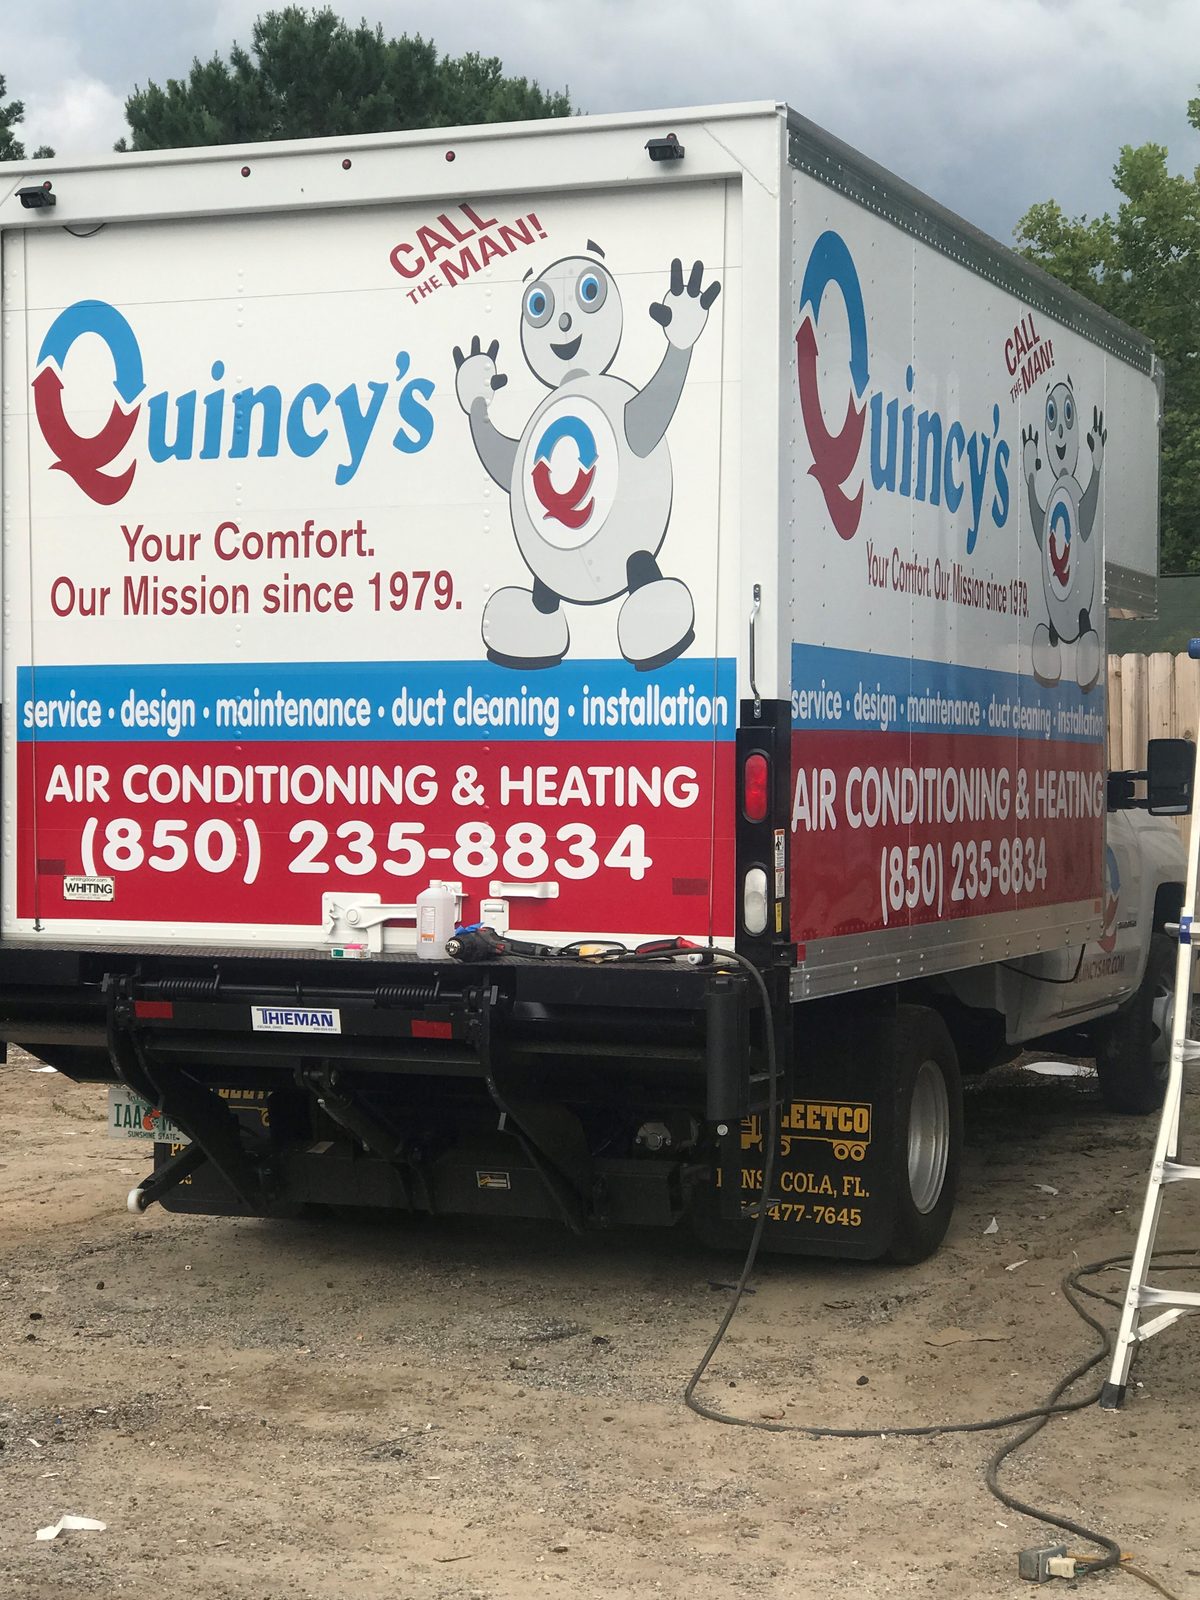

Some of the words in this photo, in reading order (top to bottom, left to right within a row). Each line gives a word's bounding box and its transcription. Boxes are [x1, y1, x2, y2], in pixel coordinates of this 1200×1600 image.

[389, 202, 498, 279] CALL
[406, 274, 443, 305] THE
[439, 212, 549, 288] MAN!
[1005, 312, 1040, 376] CALL
[1010, 378, 1023, 404] THE
[1021, 339, 1055, 394] MAN!
[31, 299, 436, 506] Quincy's
[795, 230, 1010, 555] Quincy's
[121, 524, 201, 562] Your
[214, 520, 375, 561] Comfort.
[50, 576, 111, 617] Our
[123, 574, 249, 616] Mission
[262, 572, 354, 614] since
[368, 570, 462, 611] 1979.
[866, 541, 889, 589] Your
[892, 547, 931, 598] Comfort.
[934, 557, 950, 601] Our
[952, 562, 984, 609] Mission
[986, 572, 1007, 613] since
[1009, 579, 1030, 618] 1979.
[23, 689, 102, 728] service
[121, 688, 195, 737] design
[216, 687, 371, 727] maintenance
[392, 686, 446, 726] duct
[453, 685, 560, 737] cleaning
[582, 684, 727, 726] installation
[791, 679, 842, 720] service
[853, 681, 897, 731] design
[907, 687, 980, 726] maintenance
[988, 693, 1010, 728] duct
[1012, 697, 1050, 740] cleaning
[1058, 702, 1103, 737] installation
[45, 764, 110, 802] AIR
[122, 764, 439, 806] CONDITIONING
[452, 765, 485, 806] &
[500, 765, 699, 808] HEATING
[791, 767, 837, 833] AIR
[845, 766, 1010, 829] CONDITIONING
[1015, 768, 1030, 820] &
[1035, 769, 1103, 819] HEATING
[81, 817, 261, 884] (850)
[288, 820, 653, 880] 235-8834
[880, 842, 944, 926] (850)
[951, 837, 1048, 902] 235-8834
[65, 883, 113, 894] WHITING
[256, 1008, 334, 1027] THIEMAN
[128, 1131, 156, 1140] SUNSHINE
[158, 1132, 177, 1141] STATE
[780, 1103, 869, 1134] EETCO
[842, 1175, 870, 1198] FL.
